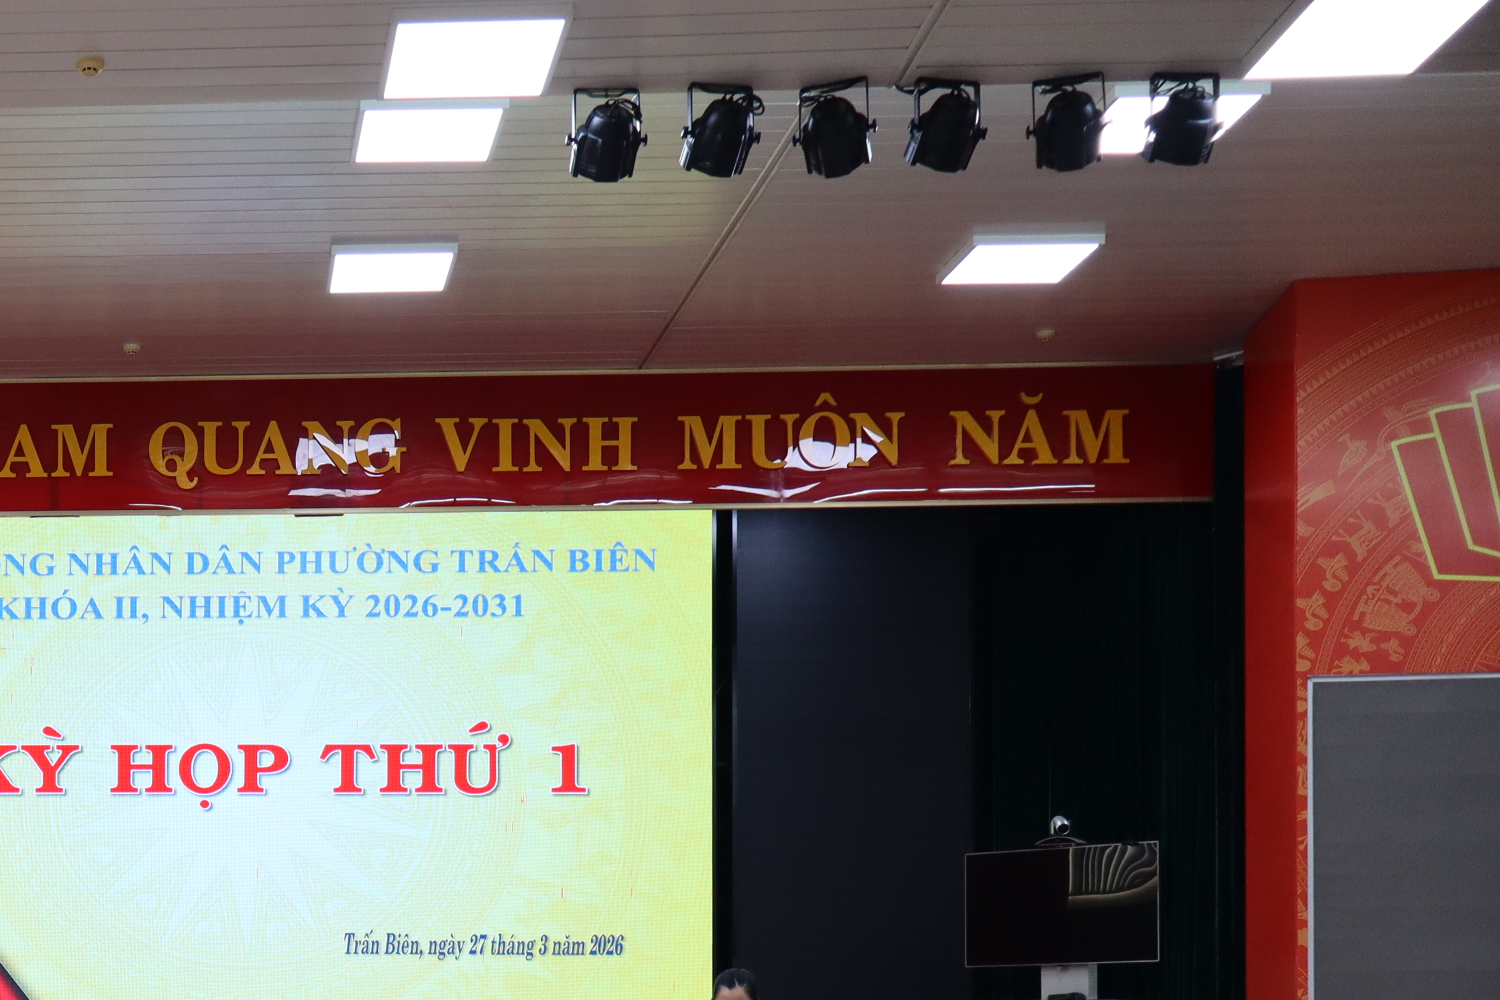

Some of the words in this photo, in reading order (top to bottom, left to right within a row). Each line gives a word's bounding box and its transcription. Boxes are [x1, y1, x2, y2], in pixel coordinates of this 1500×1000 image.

[148, 417, 407, 490] QUANG
[434, 417, 638, 473] VINH
[676, 392, 905, 470] MUÔN
[947, 392, 1130, 466] NĂM
[66, 545, 173, 576] NHÂN
[184, 544, 263, 575] DÂN
[275, 543, 441, 574] PHƯỜNG
[450, 541, 555, 573] TRẤN
[566, 541, 657, 573] BIÊN
[113, 596, 149, 624] II,
[159, 591, 287, 625] NHIỆM
[300, 587, 355, 618] KỲ
[365, 593, 525, 618] 2026-2031
[109, 743, 292, 811] HỌP
[319, 720, 512, 796] THỨ
[550, 743, 590, 796] 1
[344, 930, 380, 955] Trấn
[384, 933, 423, 959] Biên,
[428, 933, 465, 960] ngày
[468, 934, 487, 955] 27
[491, 933, 536, 960] tháng
[538, 934, 548, 955] 3
[551, 936, 585, 956] năm
[589, 934, 625, 956] 2026
